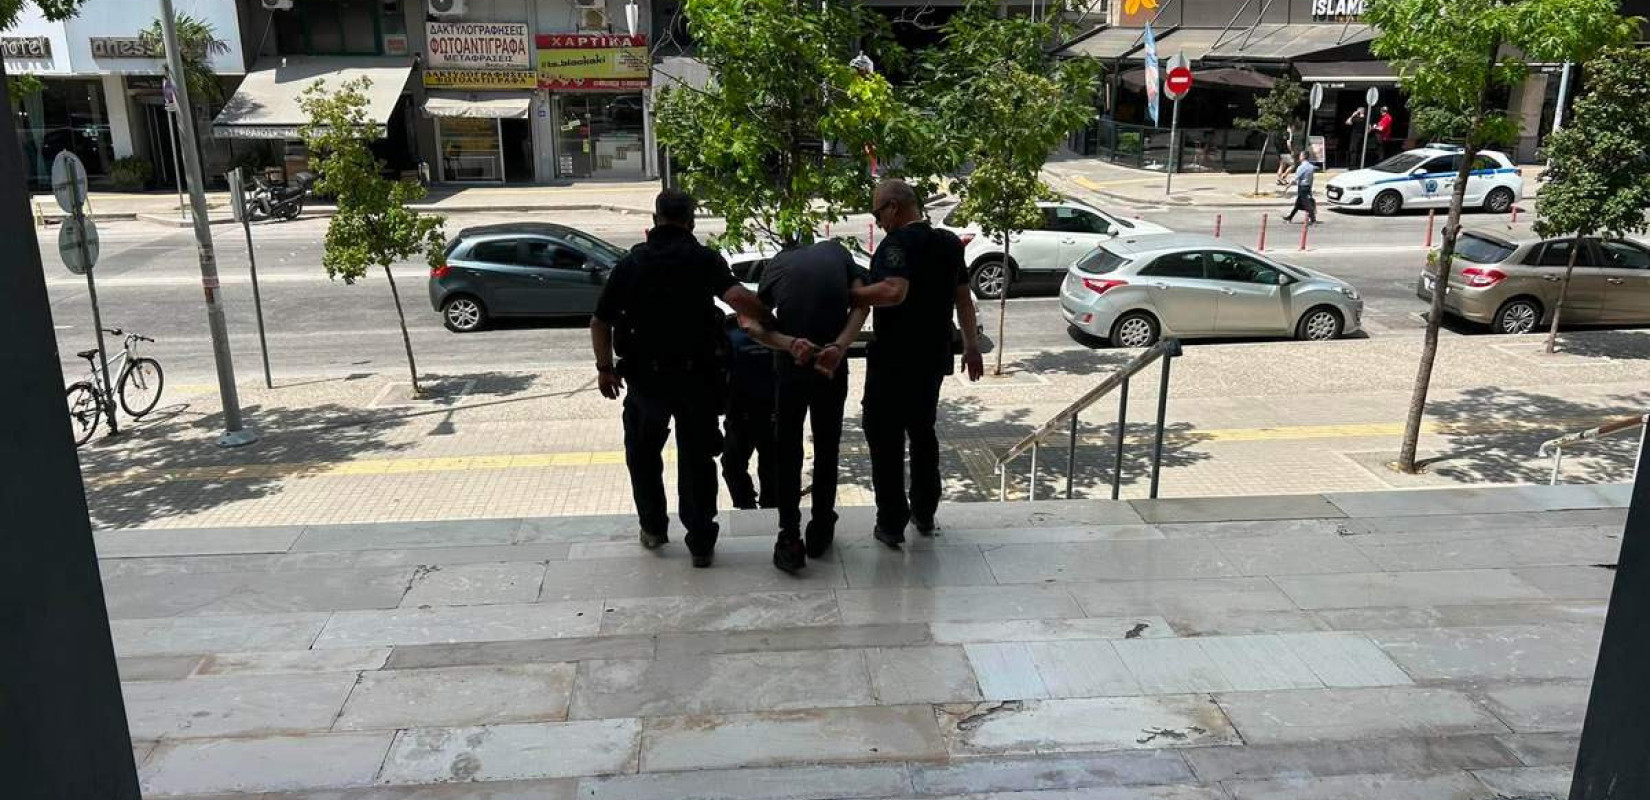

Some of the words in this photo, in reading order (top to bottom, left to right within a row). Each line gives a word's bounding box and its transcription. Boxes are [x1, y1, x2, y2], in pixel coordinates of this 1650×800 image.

[430, 25, 525, 35] ΔΑΚΤΥΛΟΓΡΑΦΗΣΕΙΣ
[430, 37, 526, 54] ΦΩΤΟΑΝΤΙΓΡΑΦΑ
[551, 37, 632, 47] ΧΑΡΤΙΚΑ
[444, 54, 513, 62] ΜΕΤΑΦΡΑΣΕΙΣ
